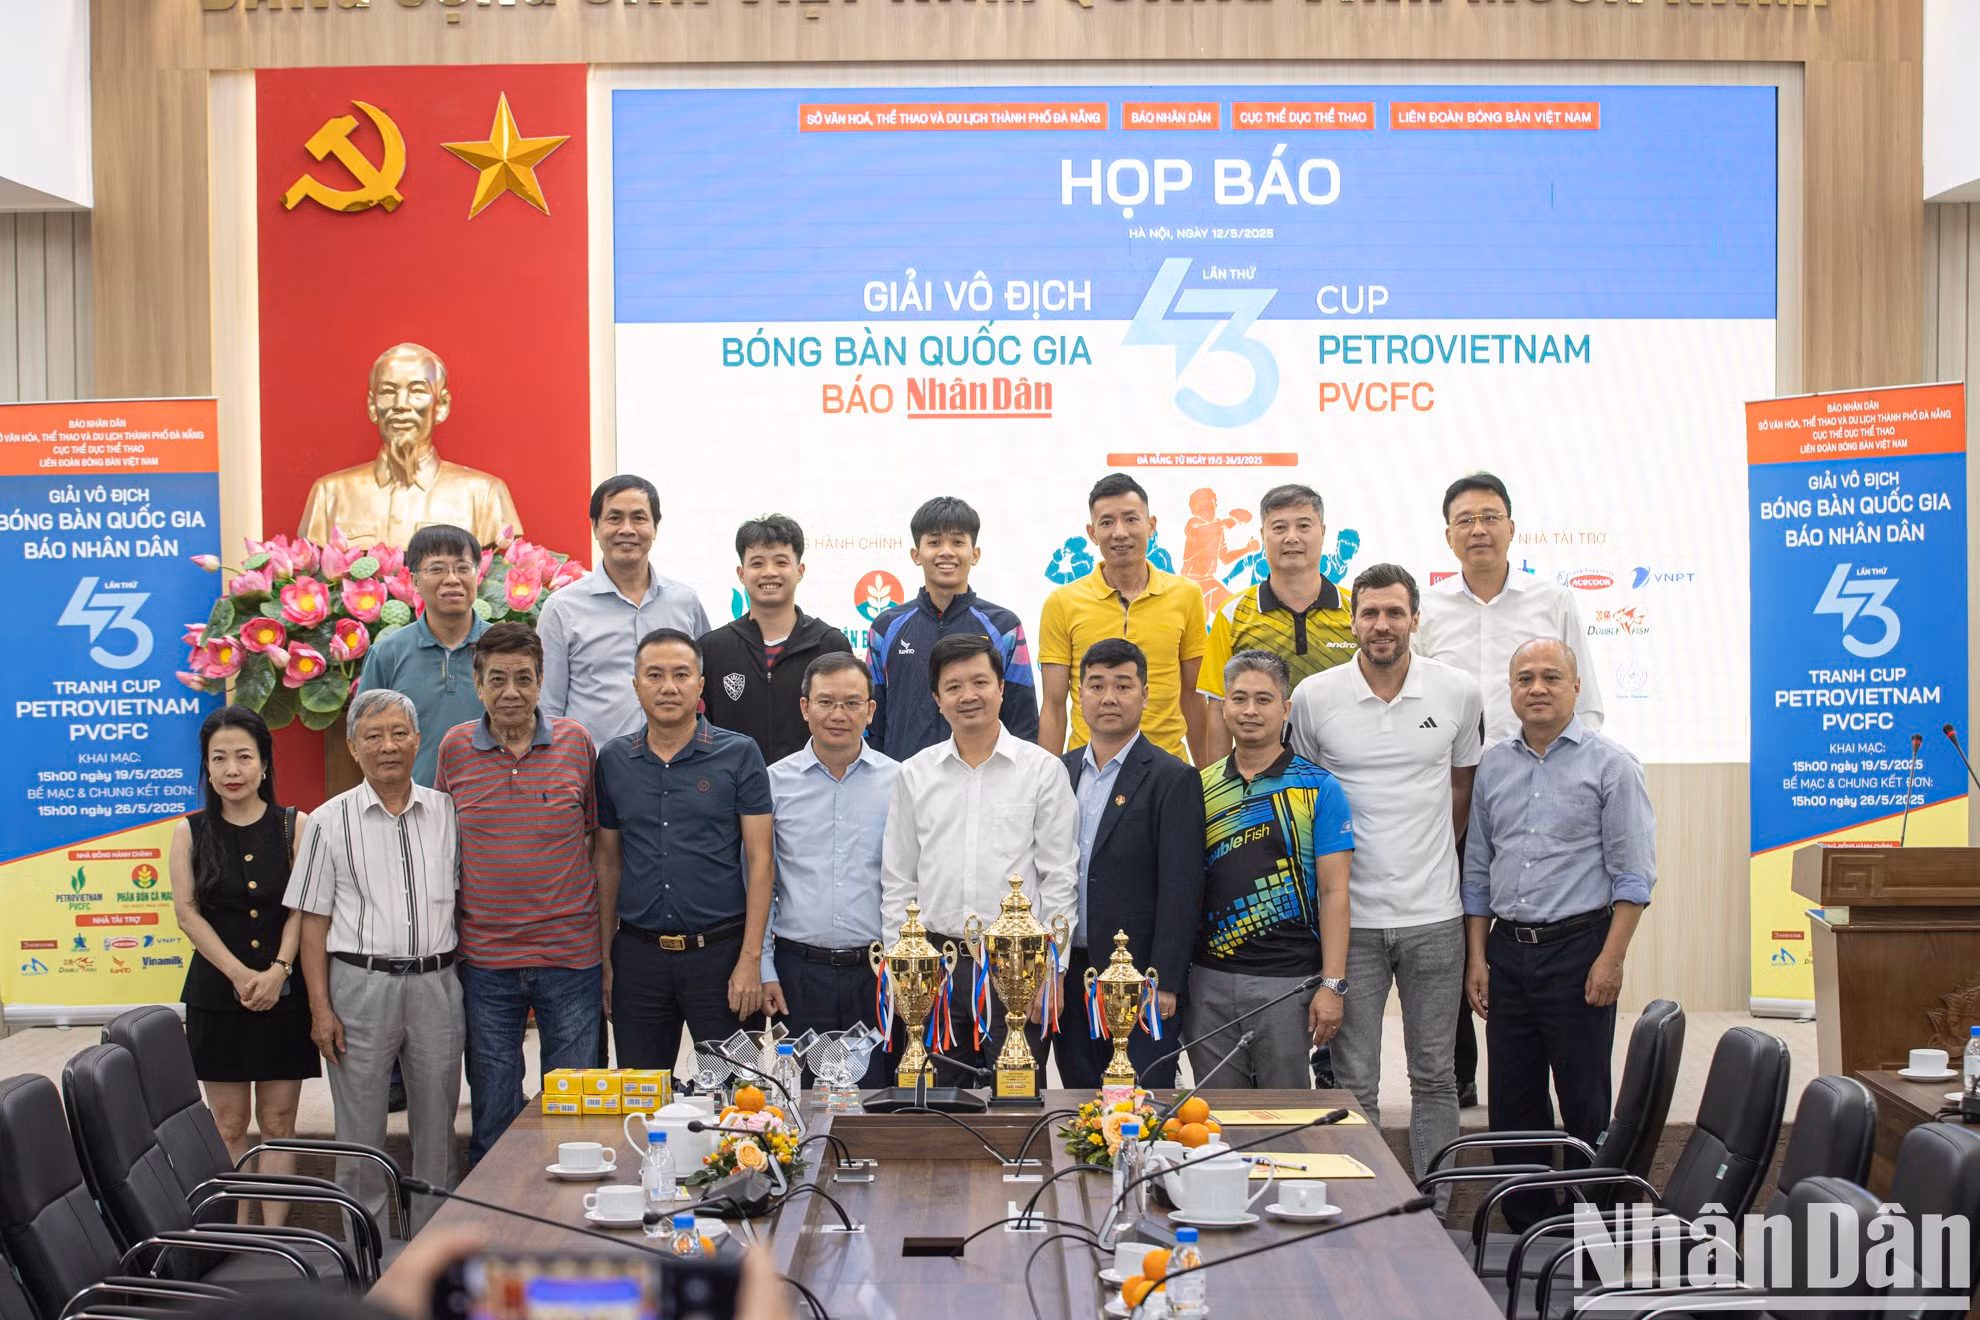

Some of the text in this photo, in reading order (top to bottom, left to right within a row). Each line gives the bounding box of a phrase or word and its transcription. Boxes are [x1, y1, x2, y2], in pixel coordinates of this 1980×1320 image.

[824, 111, 846, 125] VĂN
[876, 108, 898, 125] THỂ
[899, 112, 928, 124] THAO
[929, 110, 944, 124] VÀ
[946, 113, 962, 124] DU
[964, 113, 988, 127] LỊCH
[990, 110, 1026, 124] THÀNH
[1028, 108, 1051, 124] PHỐ
[1053, 110, 1068, 124] ĐÀ
[1070, 109, 1100, 124] NẴNG
[1131, 110, 1211, 124] BÁO NHÂN DÂN
[1240, 108, 1367, 126] CỤC THỂ DỤC THỂ THAO
[1398, 110, 1592, 126] LIÊN ĐOÀN BÓNG BÀN VIỆT NAM
[1061, 143, 1340, 219] HỌP BÁO
[1128, 227, 1274, 242] HÀ NỘI, NGÀY 12/5/2025
[1202, 265, 1257, 280] LẦN THỨ
[863, 268, 1092, 320] GIẢI VÔ ĐỊCH
[1315, 286, 1390, 314] CUP
[723, 320, 1092, 367] BÓNG BÀN QUỐC GIA
[1121, 258, 1280, 429] 43
[1318, 334, 1590, 364] PETROVIETNAM
[822, 374, 1052, 414] BÁO Nhân Dân
[1318, 382, 1435, 412] PVCFC
[1827, 400, 1880, 412] BÁO NHÂN DÂN
[1812, 426, 1895, 442] CỤC THỂ DỤC THỂ THAO
[1800, 438, 1908, 454] LIÊN ĐOÀN BÓNG BÀN VIỆT NAM
[1136, 454, 1148, 464] ĐÀ
[1175, 454, 1185, 464] TỪ
[1186, 455, 1207, 464] NGÀY
[1808, 470, 1900, 490] GIẢI VÔ ĐỊCH
[49, 485, 150, 505] GIẢI VÔ ĐỊCH
[1760, 487, 1951, 520] BÓNG BÀN QUỐC GIA
[0, 504, 206, 530] BÓNG BÀN QUỐC GIA
[1518, 530, 1548, 544] NHÀ
[1553, 530, 1573, 544] TÀI
[1786, 519, 1924, 548] BÁO NHÂN DÂN
[24, 534, 178, 559] BÁO NHÂN DÂN
[816, 534, 854, 550] HÀNH
[859, 534, 902, 550] CHÍNH
[1654, 573, 1696, 582] VNPT
[1856, 566, 1888, 576] LẦN THỨ
[104, 580, 138, 589] LẦN THỨ
[1812, 563, 1900, 658] 43
[56, 576, 154, 670] 43
[1808, 668, 1906, 684] TRANH CUP
[53, 680, 162, 694] TRANH CUP
[1775, 686, 1940, 708] PETROVIETNAM
[16, 698, 200, 718] PETROVIETNAM
[1822, 712, 1894, 730] PVCFC
[70, 722, 148, 742] PVCFC
[1830, 742, 1886, 756] KHAI MẠC:
[78, 752, 141, 766] KHAI MẠC:
[1792, 759, 1924, 773] 15h00 ngày 19/5/2025
[38, 768, 183, 783] 15h00 ngày 19/5/2025
[1782, 776, 1798, 788] BẾ
[1800, 778, 1826, 790] MẠC
[1828, 778, 1836, 788] &
[1838, 778, 1878, 788] CHUNG
[1880, 774, 1903, 787] KẾT
[28, 782, 195, 800] BẾ MẠC & CHUNG KẾT ĐƠN:
[1792, 794, 1924, 808] 15h00 ngày 26/5/2025
[38, 802, 186, 817] 15h00 ngày 26/5/2025
[1206, 824, 1270, 864] ouble Fish
[56, 894, 102, 902] PETROVIETNAM
[92, 916, 110, 924] NHÀ
[112, 914, 124, 924] TÀI
[142, 956, 182, 966] Vinamilk
